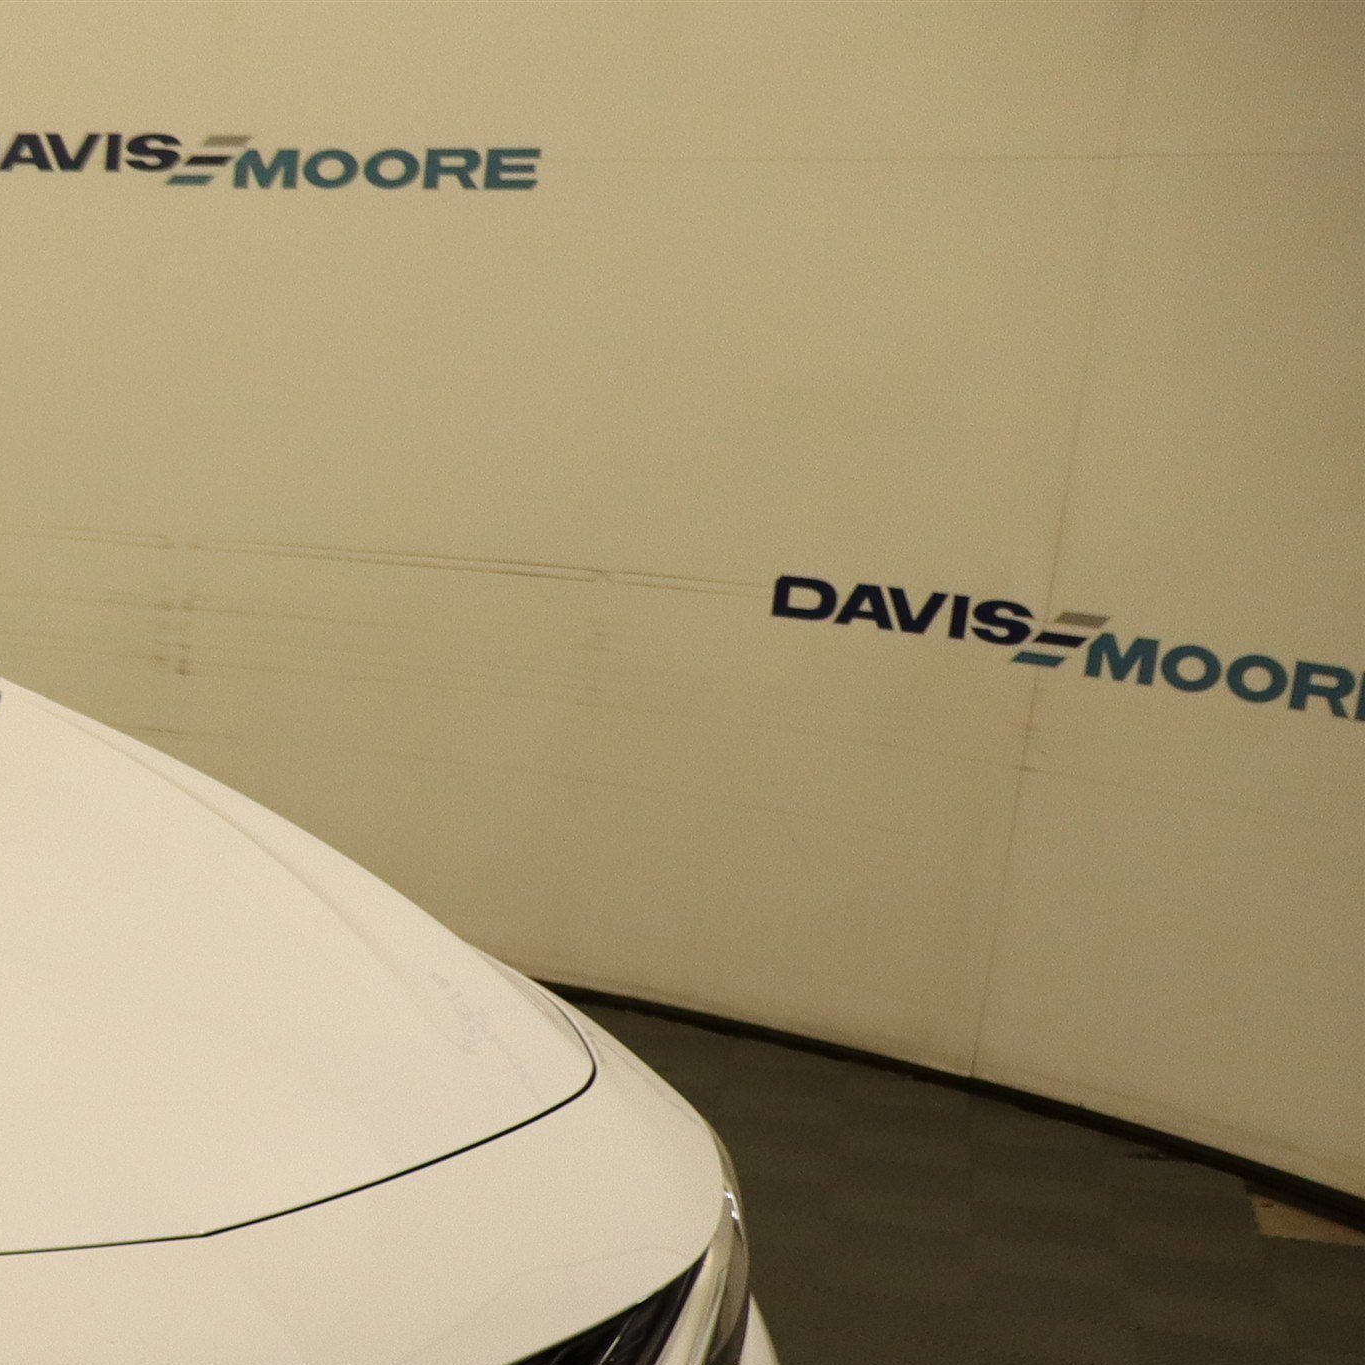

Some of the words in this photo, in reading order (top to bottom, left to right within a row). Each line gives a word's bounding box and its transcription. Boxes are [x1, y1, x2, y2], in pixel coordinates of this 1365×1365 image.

[232, 147, 542, 190] MOORE
[771, 575, 1035, 645] DAVIS
[1084, 632, 1365, 722] MOOR
